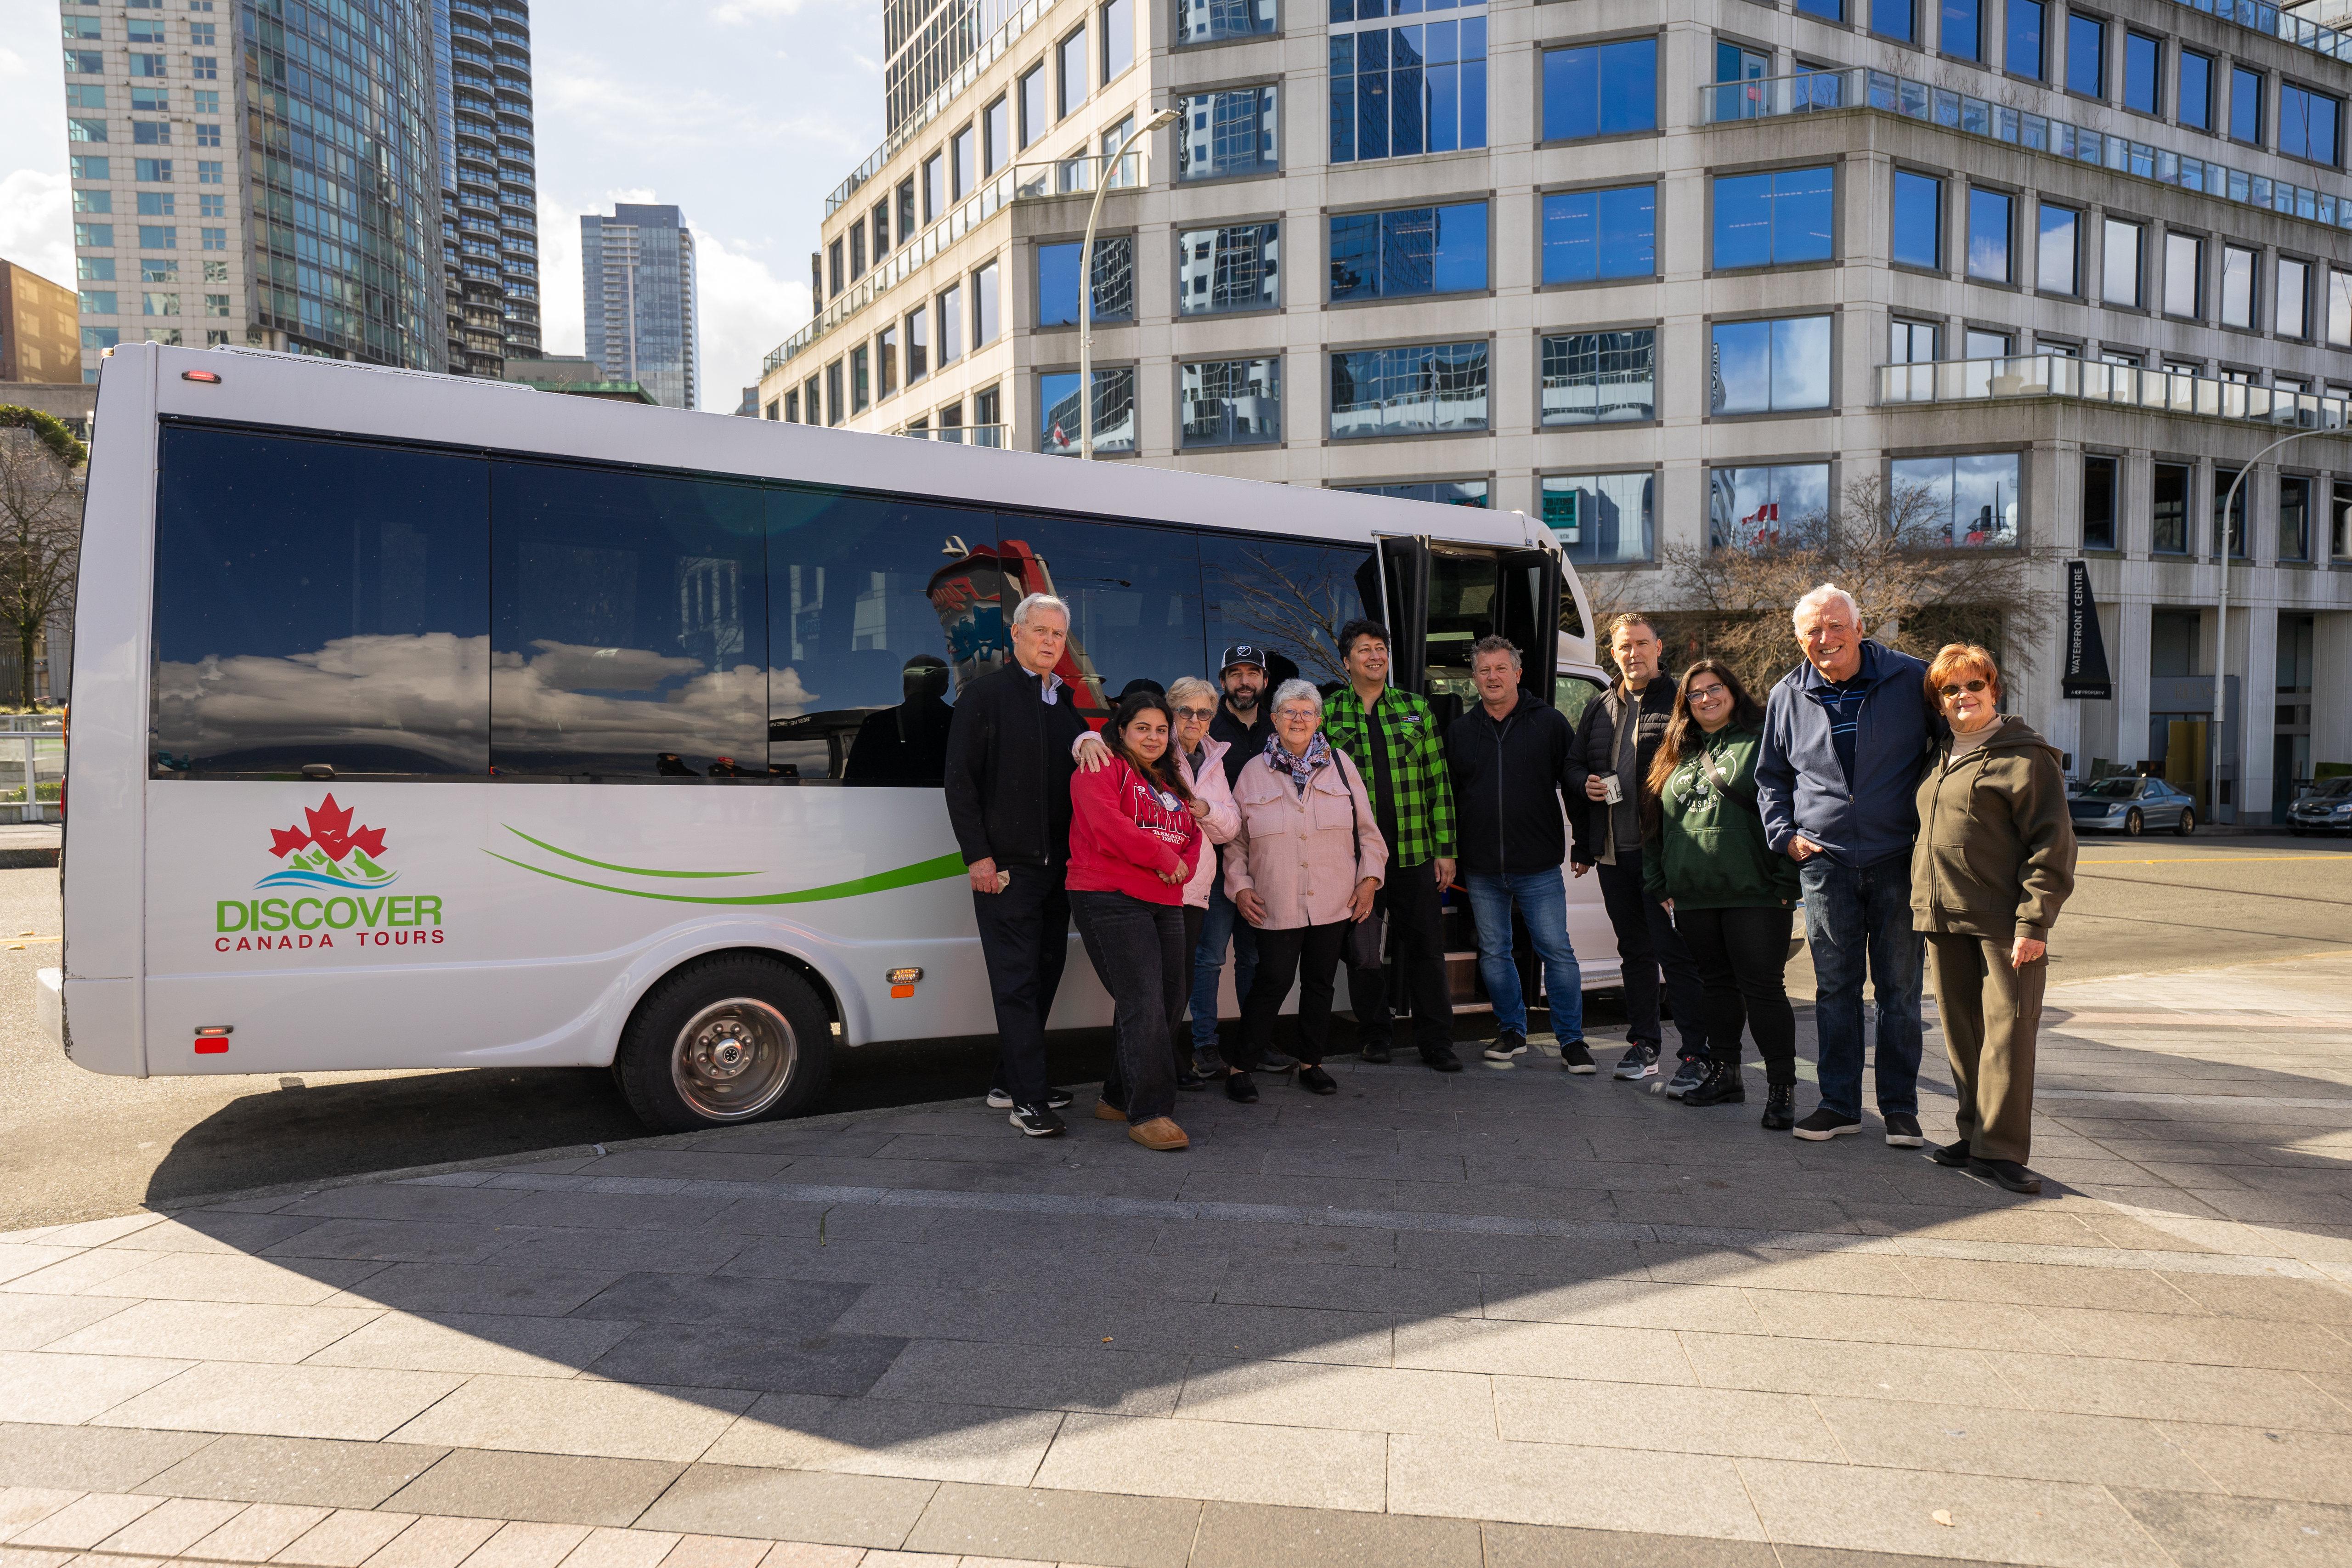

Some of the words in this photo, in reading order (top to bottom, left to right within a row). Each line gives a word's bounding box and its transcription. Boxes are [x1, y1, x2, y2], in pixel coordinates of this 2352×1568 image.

[2075, 568, 2083, 606] CENTRE
[2071, 609, 2083, 674] WATERFRONT
[1687, 794, 1718, 808] JASPER
[1706, 802, 1717, 810] LOUISE
[1152, 830, 1185, 842] TASMANIAN
[1162, 836, 1181, 844] DEVIL
[217, 895, 442, 932] DISCOVER
[215, 934, 334, 952] CANADA
[356, 929, 444, 946] TOURS
